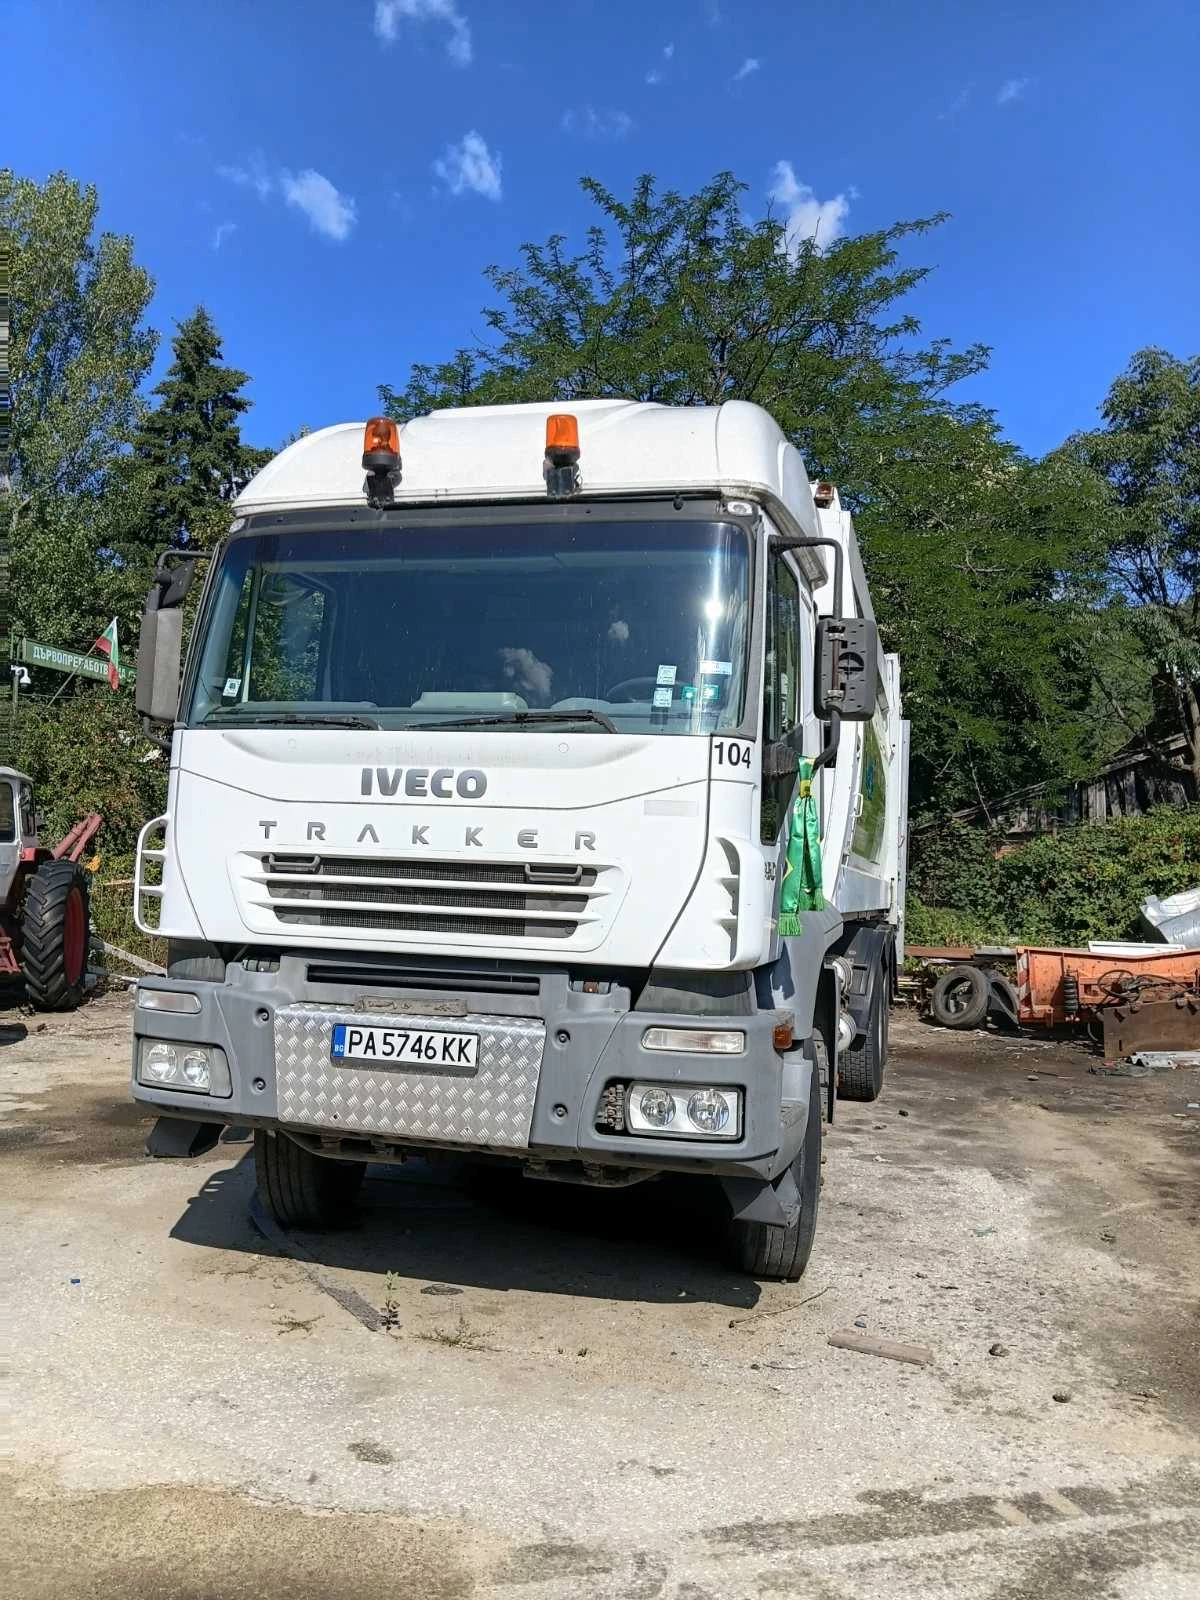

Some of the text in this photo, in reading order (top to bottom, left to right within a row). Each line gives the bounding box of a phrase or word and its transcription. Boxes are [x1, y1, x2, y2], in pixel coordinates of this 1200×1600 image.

[714, 741, 751, 769] 104
[360, 767, 488, 799] IVECO
[258, 820, 597, 851] TRAKKER
